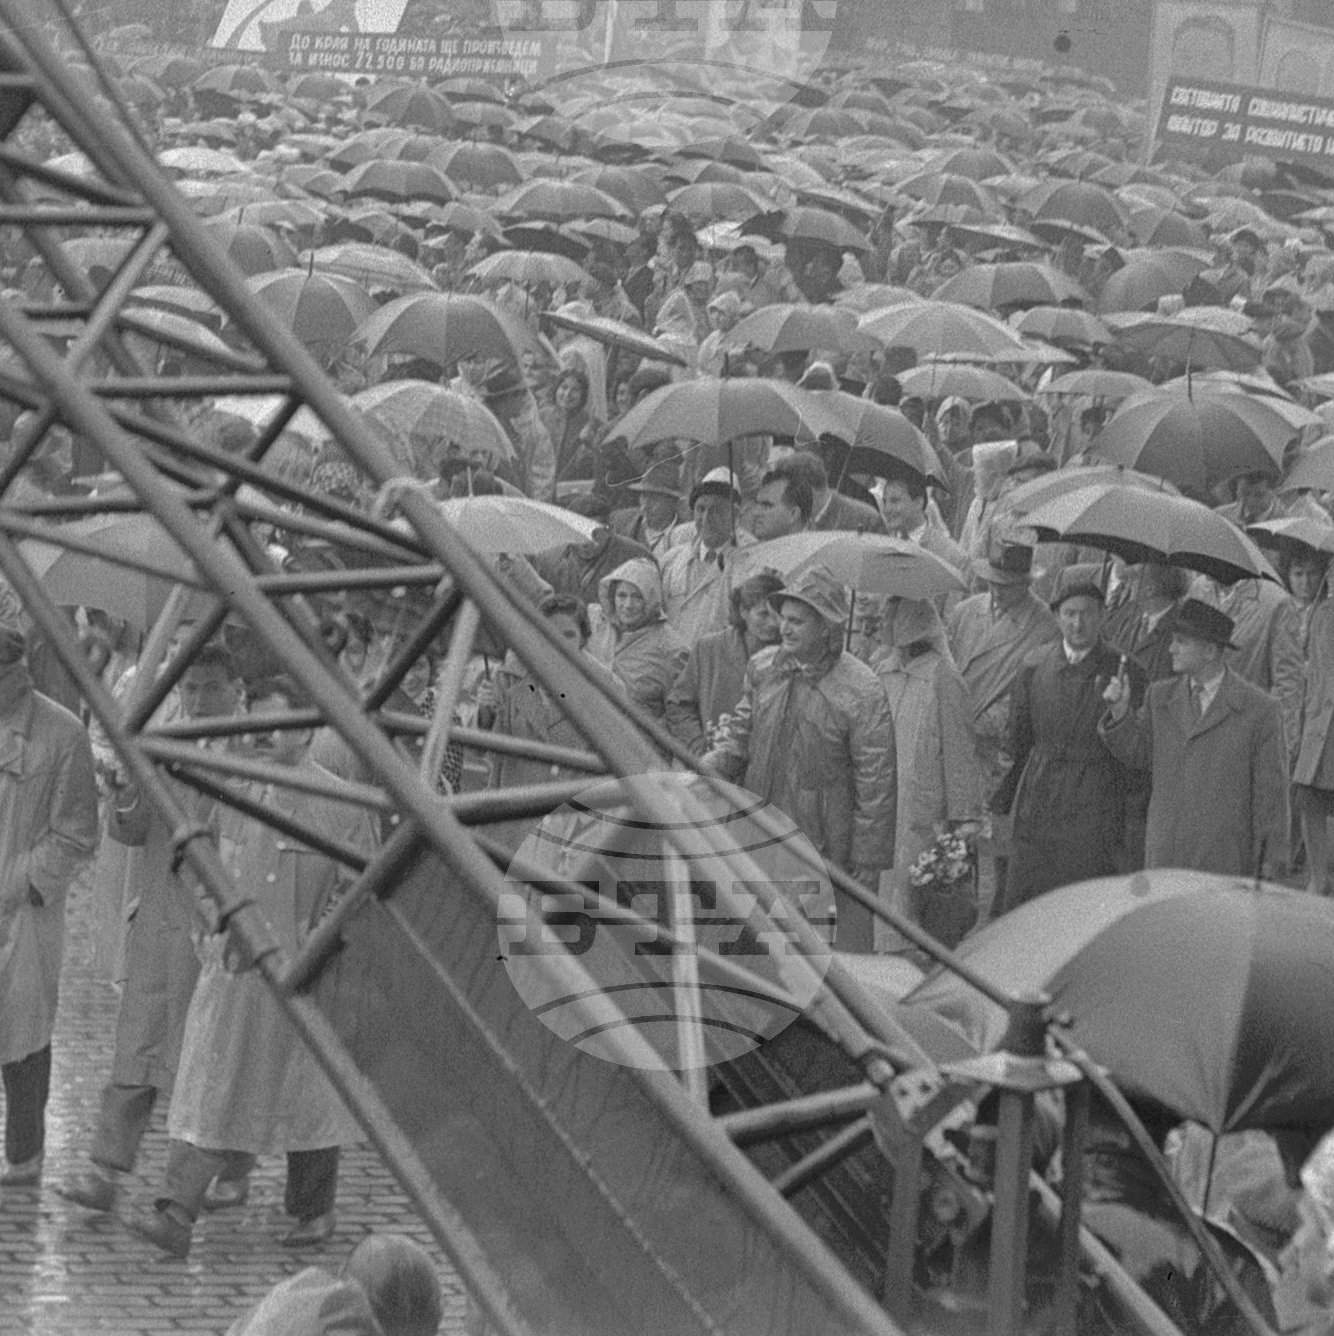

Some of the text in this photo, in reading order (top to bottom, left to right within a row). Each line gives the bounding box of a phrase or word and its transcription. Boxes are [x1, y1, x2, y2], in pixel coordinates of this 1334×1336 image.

[290, 33, 541, 57] ДО КРАЯ НА ГОДИНАТА ЩЕ ПРОИЗВЕДЕМ
[308, 53, 349, 68] ИЗНОС
[1221, 123, 1240, 141] ЗА
